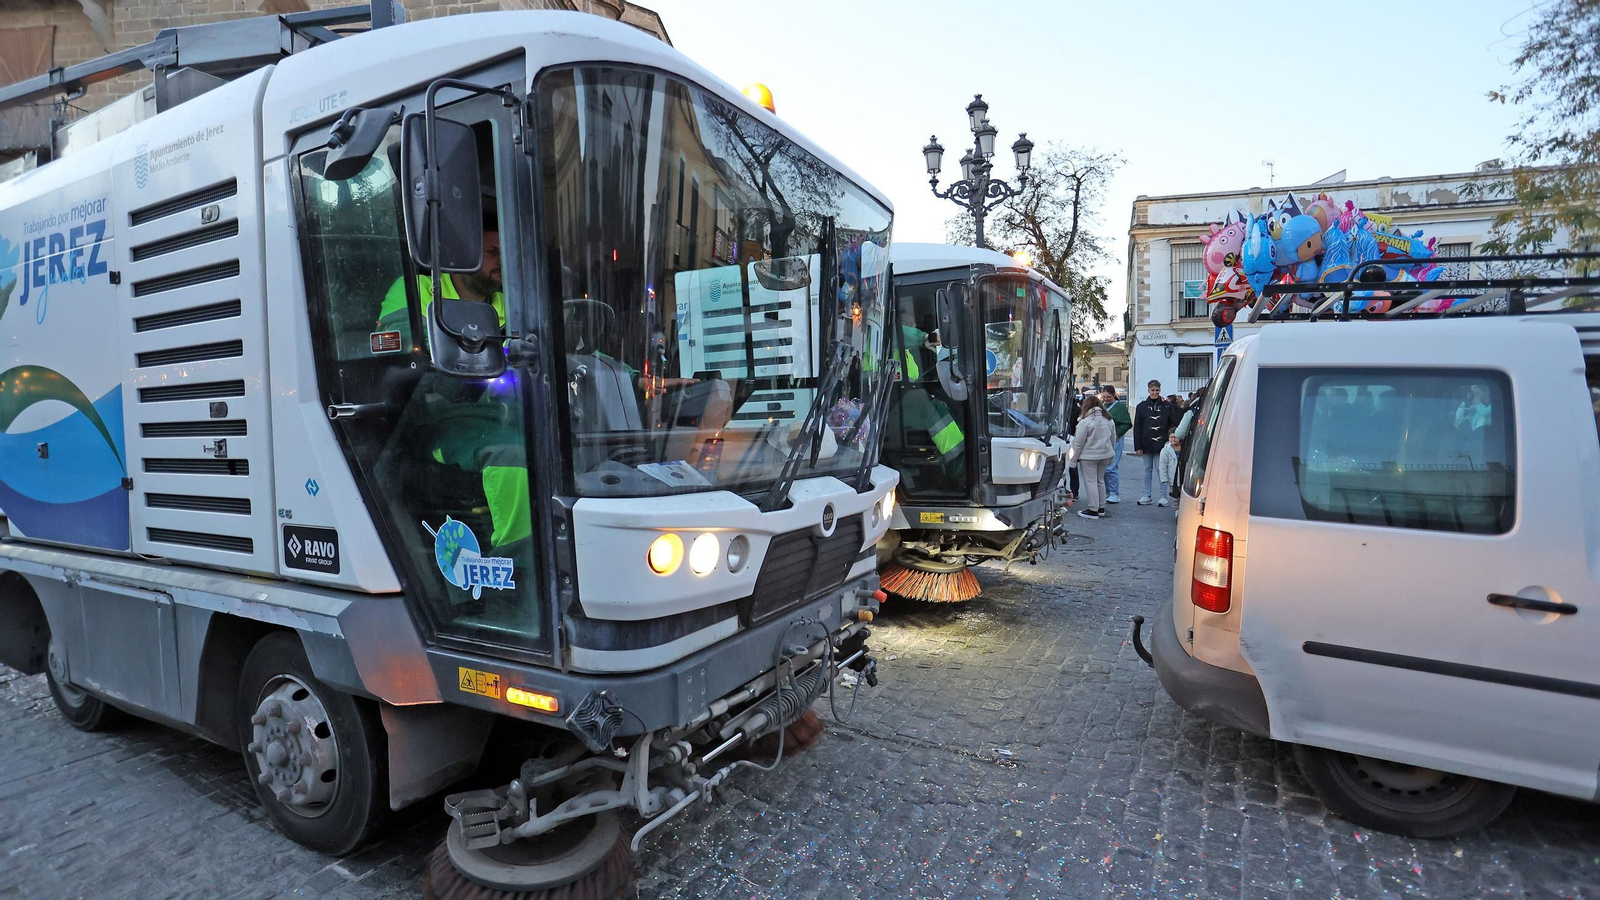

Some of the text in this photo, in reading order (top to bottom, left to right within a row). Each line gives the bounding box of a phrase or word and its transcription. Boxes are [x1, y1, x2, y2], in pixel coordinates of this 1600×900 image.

[319, 93, 338, 113] UTE
[149, 124, 225, 161] Ayuntamiento de Jerez
[149, 152, 191, 175] Medio Ambiente
[23, 197, 107, 235] Trabajando por mejorar
[20, 218, 108, 306] JEREZ
[304, 539, 335, 559] RAVO
[461, 556, 484, 564] Trabajando
[491, 557, 512, 566] mejorar
[462, 564, 514, 588] JEREZ
